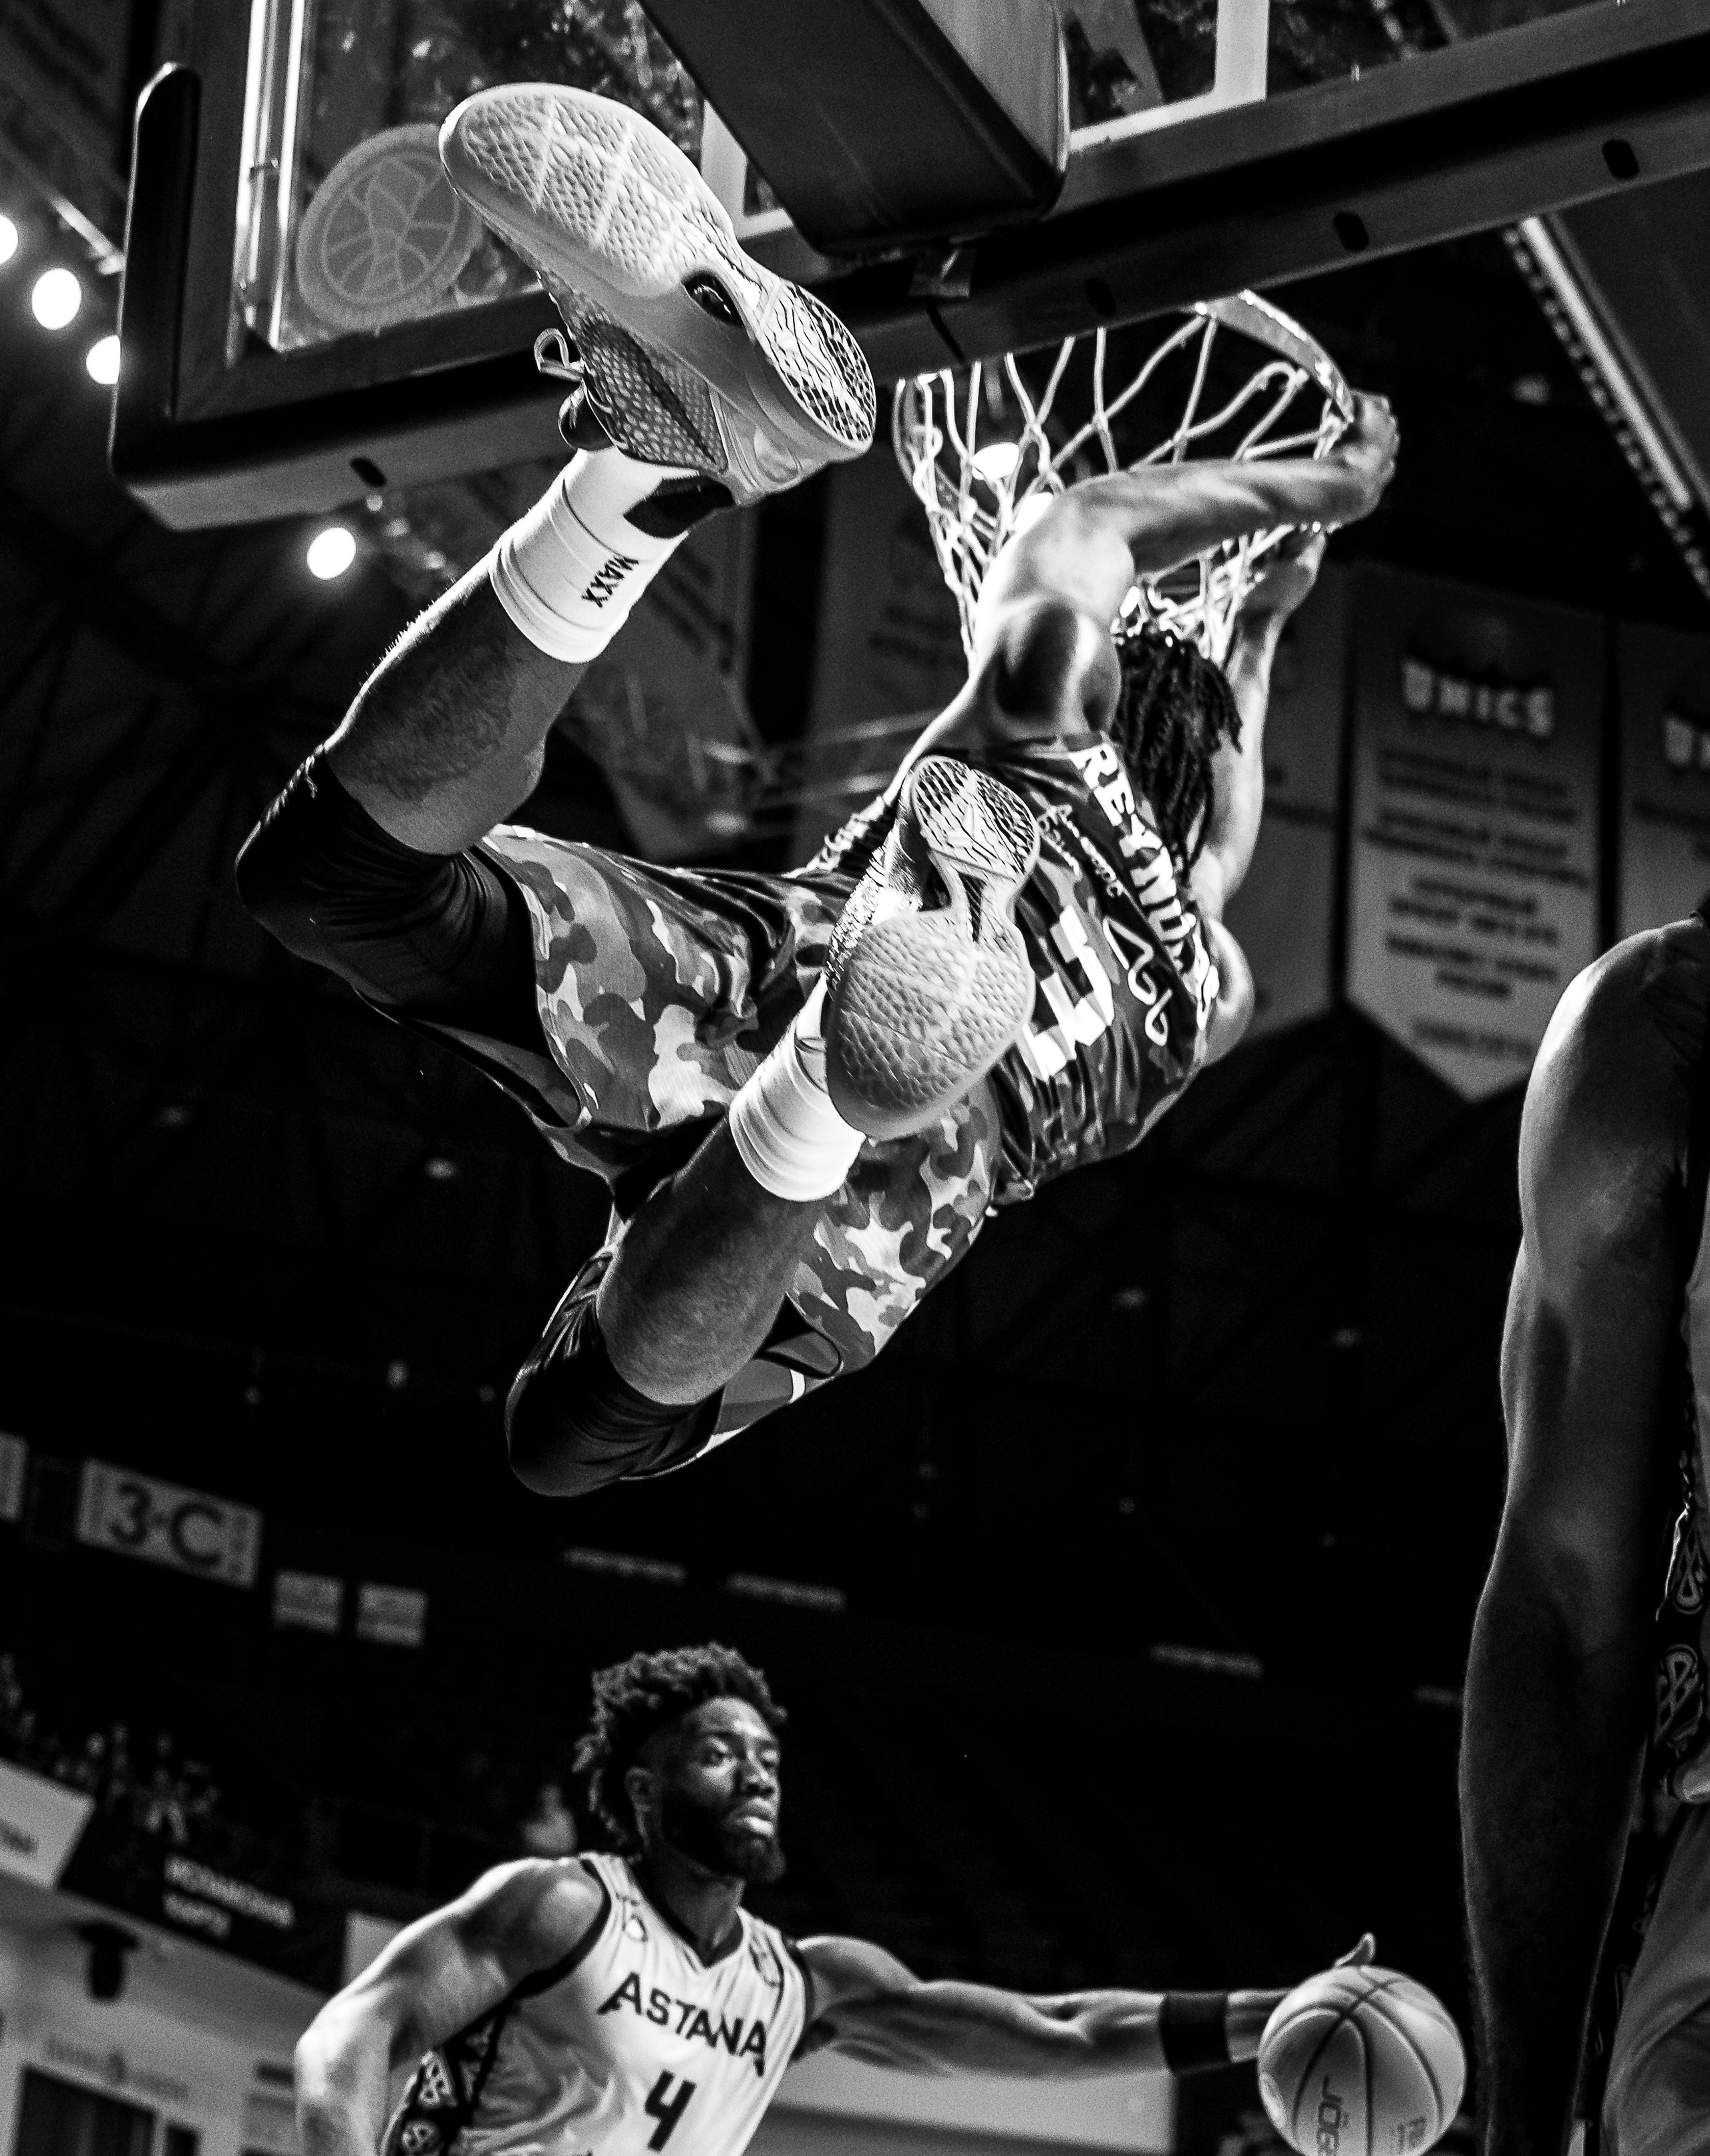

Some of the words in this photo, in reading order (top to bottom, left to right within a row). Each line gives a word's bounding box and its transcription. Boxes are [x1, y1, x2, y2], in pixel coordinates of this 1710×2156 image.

[580, 555, 639, 608] MAXX
[596, 1972, 767, 2077] ASTANA
[644, 2070, 697, 2153] 4
